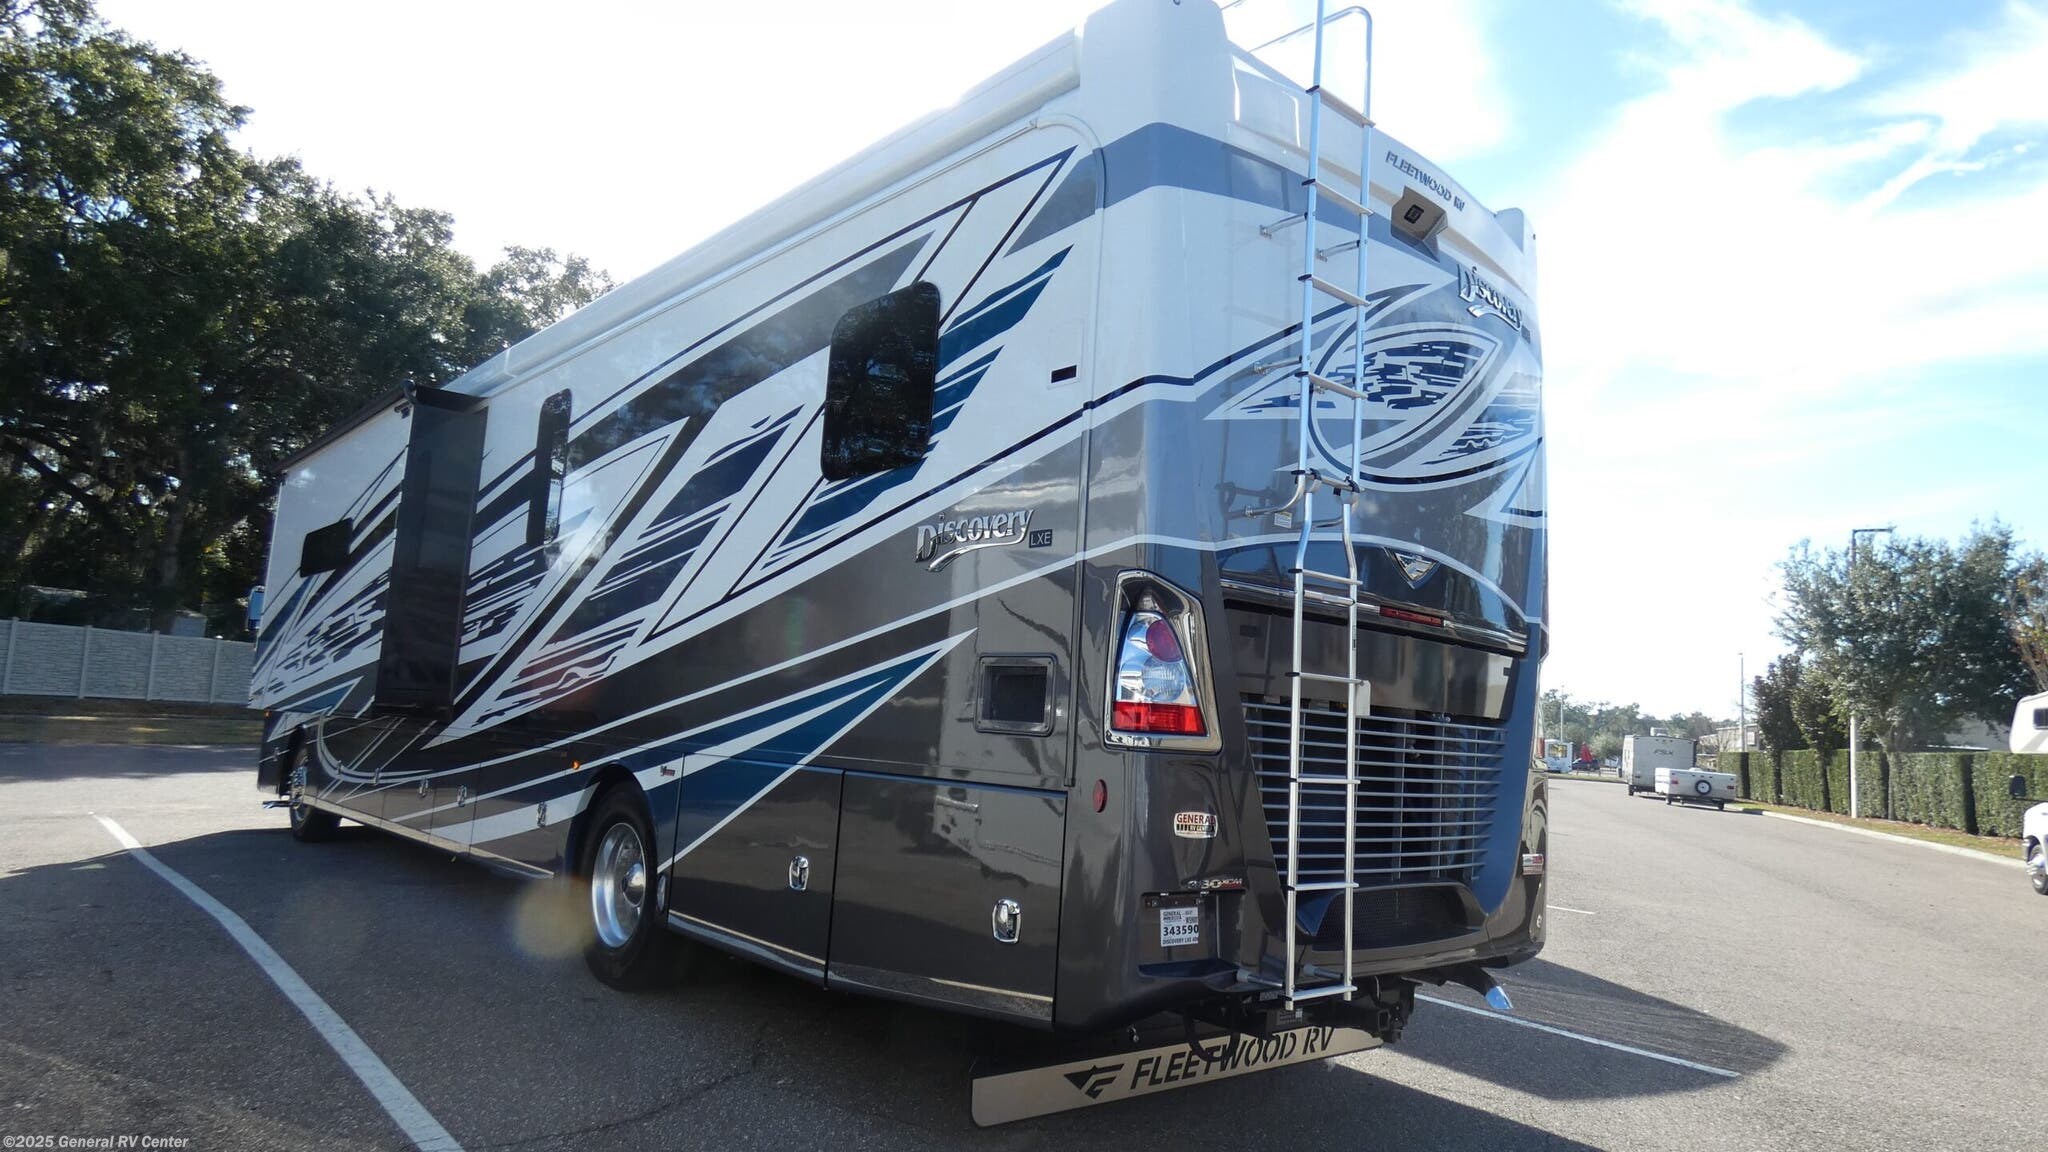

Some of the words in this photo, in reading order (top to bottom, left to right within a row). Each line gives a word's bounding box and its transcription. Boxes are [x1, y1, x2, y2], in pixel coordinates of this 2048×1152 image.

[1385, 150, 1452, 201] FLEETWOOD
[1453, 195, 1465, 212] RV
[915, 509, 1034, 572] Discovery
[1030, 531, 1052, 547] LXE
[1176, 813, 1216, 825] GENERAL
[1163, 924, 1199, 937] 343590
[1129, 1032, 1297, 1090] FLEETWOOD
[1302, 1027, 1336, 1055] RV
